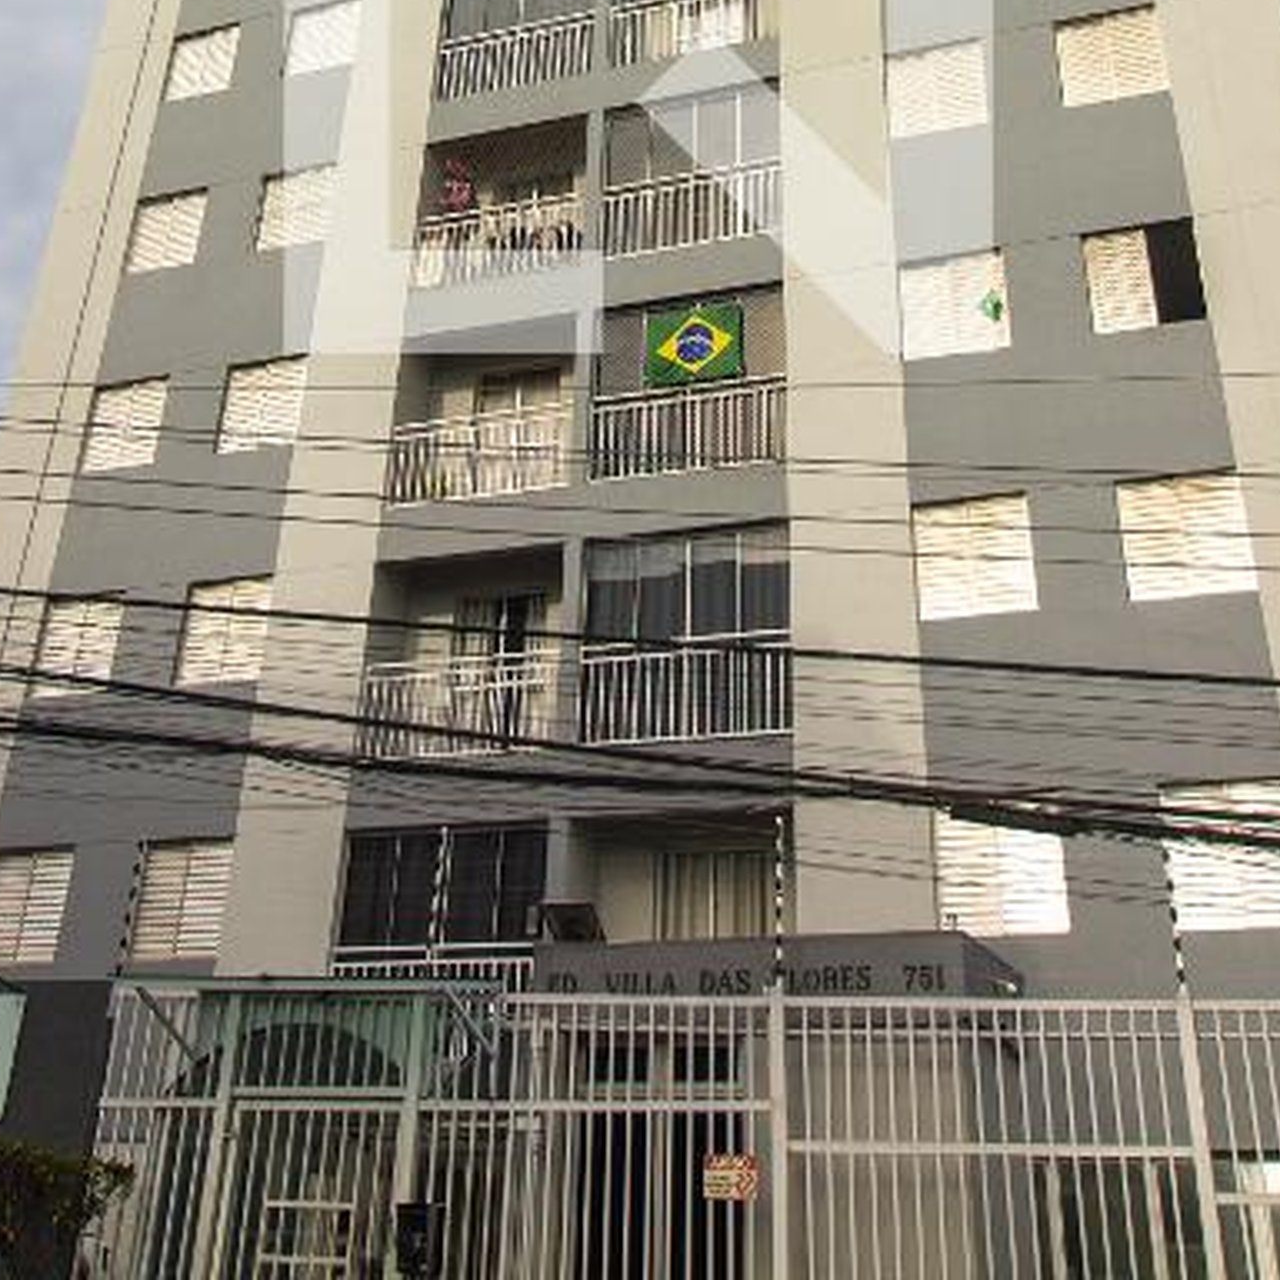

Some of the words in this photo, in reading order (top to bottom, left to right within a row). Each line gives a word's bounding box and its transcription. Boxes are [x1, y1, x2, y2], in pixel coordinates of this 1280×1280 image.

[605, 971, 678, 996] VILLA
[699, 967, 752, 996] DAS
[902, 963, 946, 992] 751
